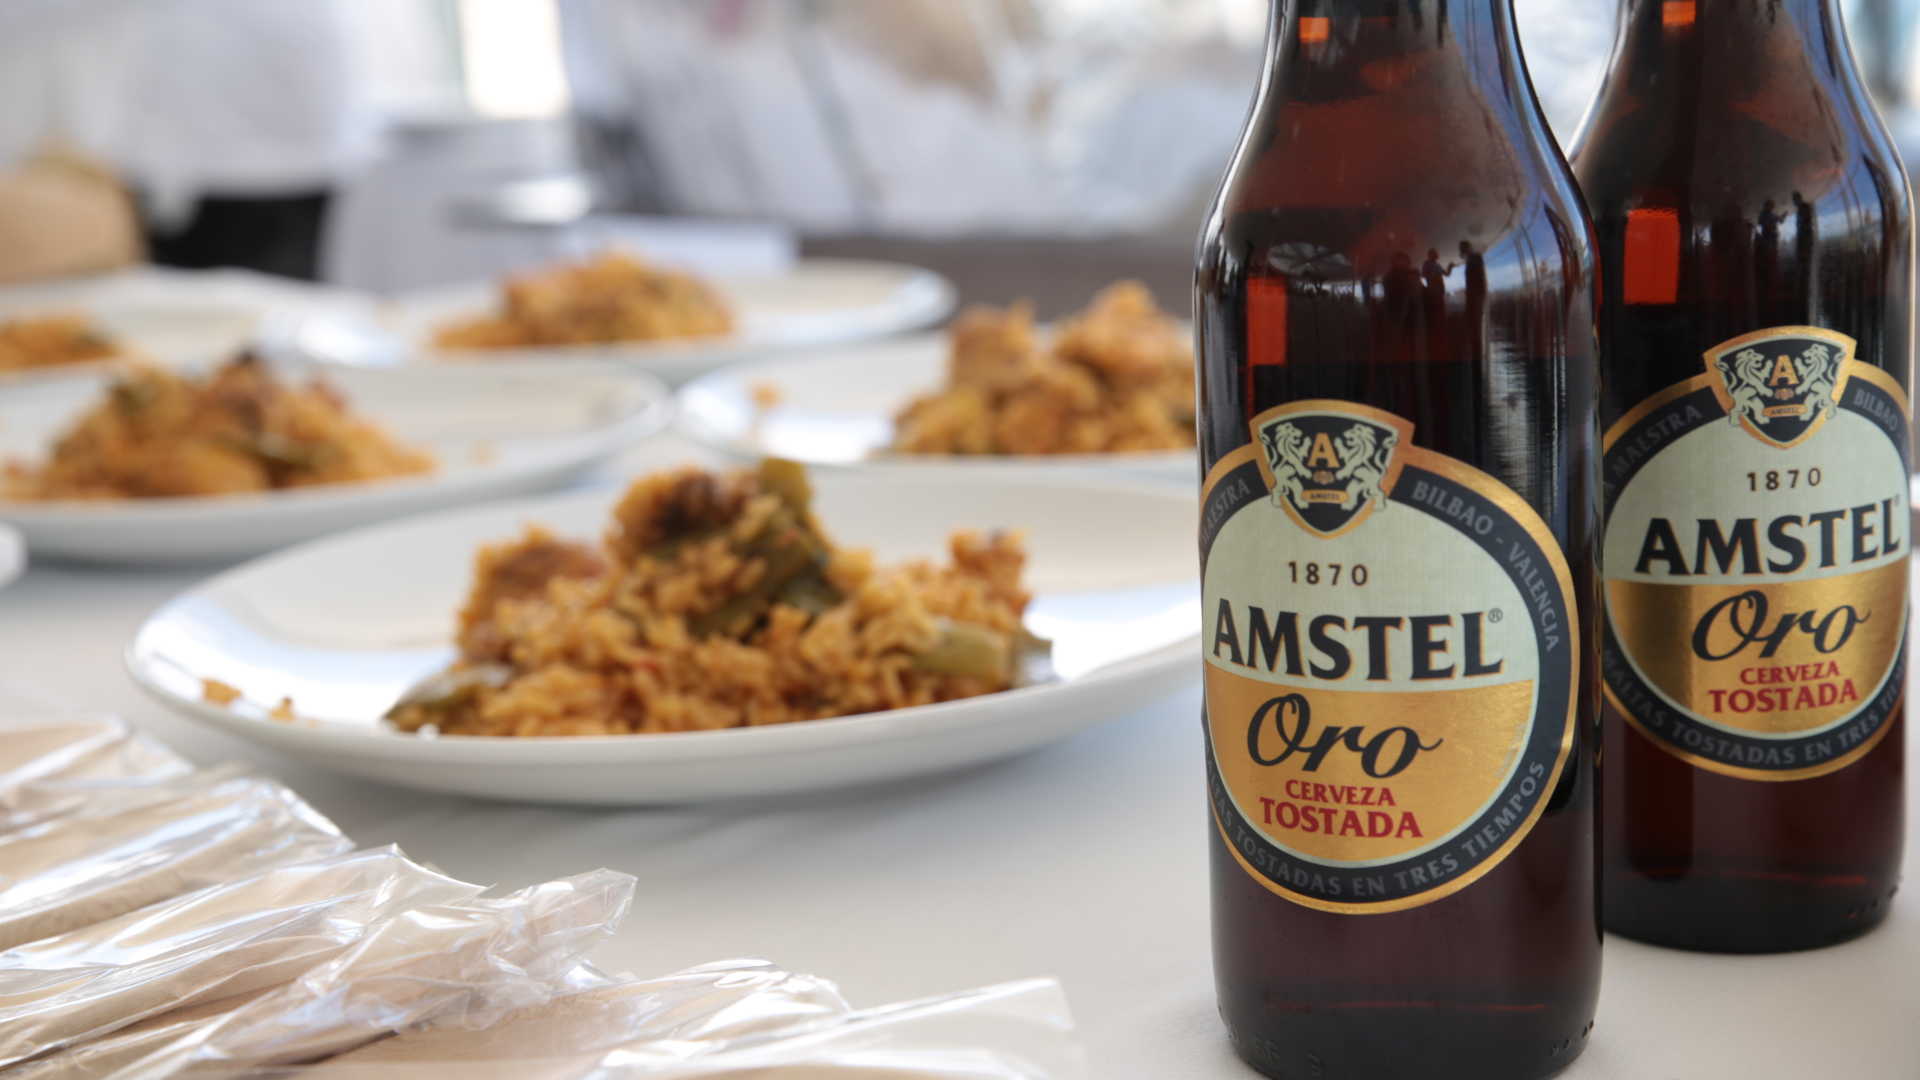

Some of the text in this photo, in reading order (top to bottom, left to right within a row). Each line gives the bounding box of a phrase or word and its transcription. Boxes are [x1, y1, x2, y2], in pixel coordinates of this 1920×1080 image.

[1768, 354, 1800, 387] A
[1853, 388, 1898, 432] BILBAO
[1307, 432, 1340, 468] A
[1746, 467, 1822, 492] 1870
[1287, 560, 1370, 587] 1870
[1411, 479, 1495, 537] BILBAO
[1508, 540, 1560, 653] VALENCIA
[1691, 589, 1872, 662] Oro
[1739, 660, 1840, 686] CERVEZA
[1708, 678, 1860, 714] TOSTADA
[1246, 692, 1444, 779] Oro
[1671, 713, 1796, 766] TOSTADAS
[1804, 738, 1832, 763] EN
[1839, 710, 1880, 748] TRES
[1284, 778, 1397, 808] CERVEZA
[1234, 827, 1342, 897] TOSTADAS
[1352, 876, 1386, 899] EN
[1394, 852, 1459, 891] TRES
[1461, 759, 1546, 857] TIEMPOS
[1258, 796, 1424, 840] TOSTADA
